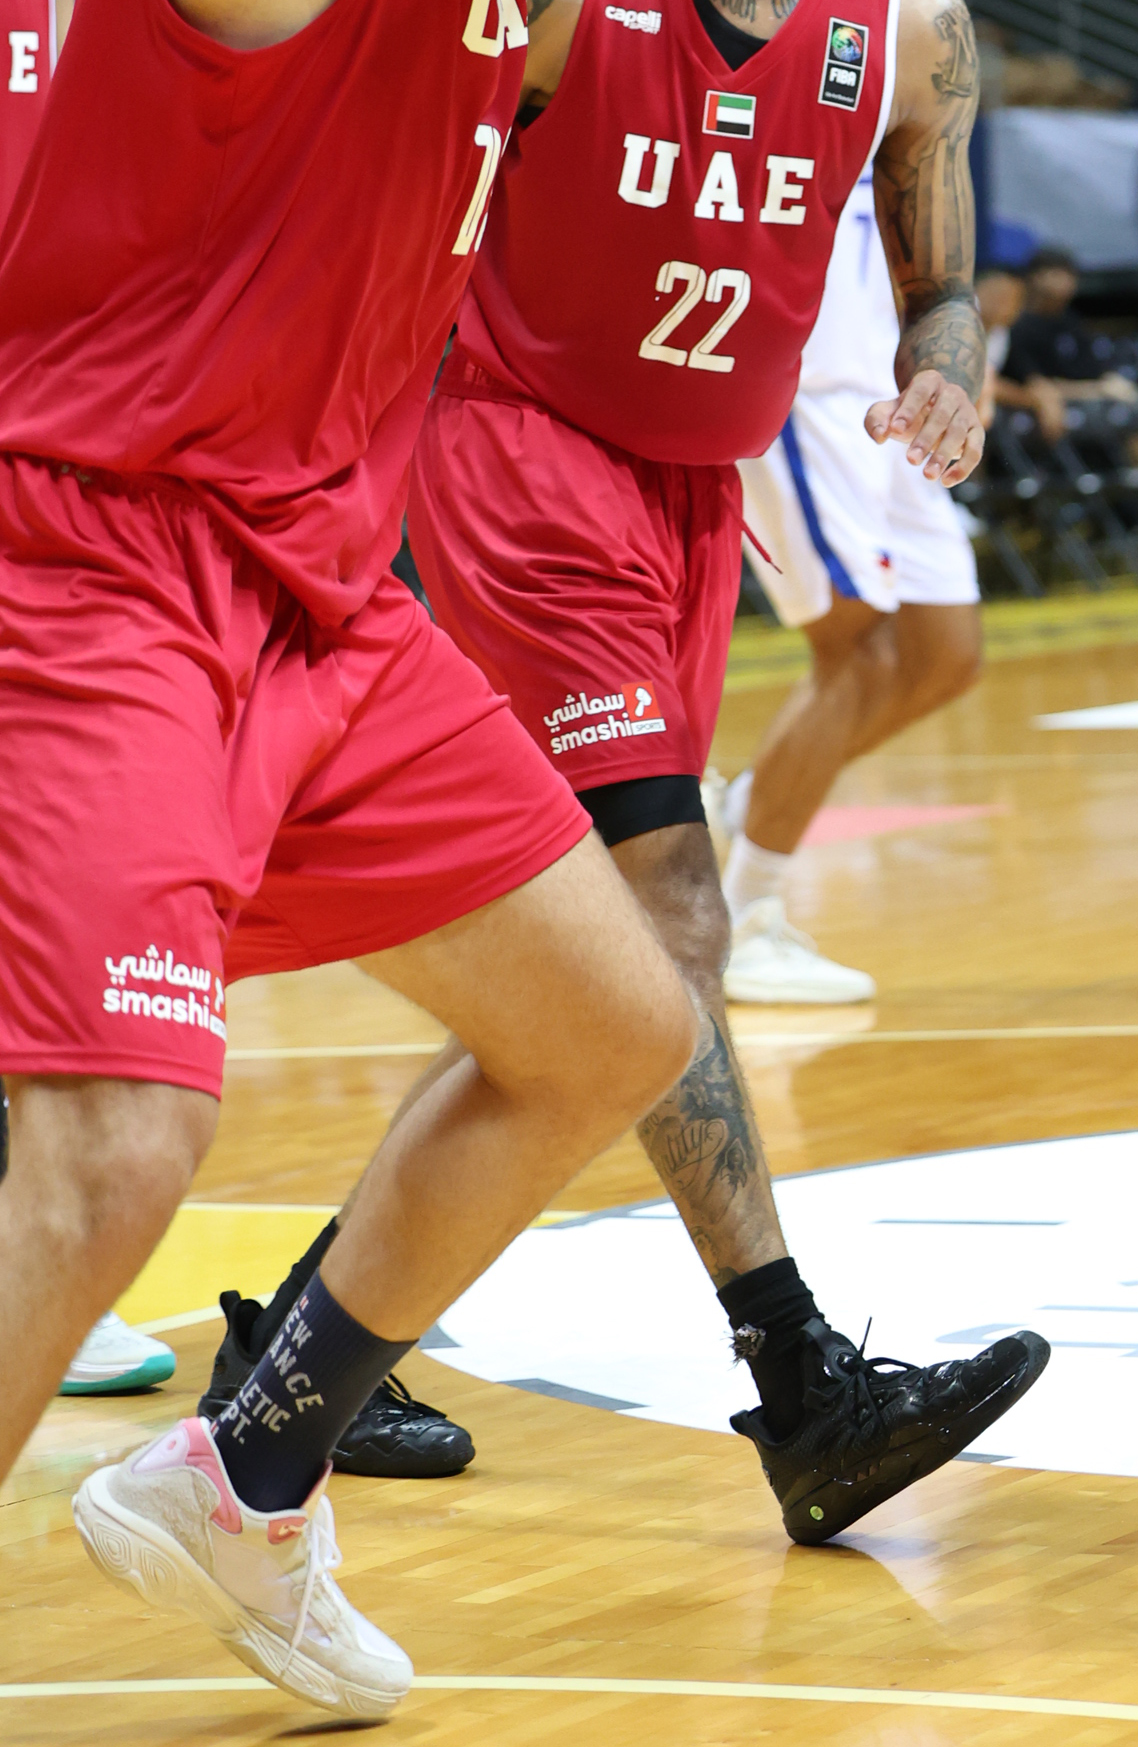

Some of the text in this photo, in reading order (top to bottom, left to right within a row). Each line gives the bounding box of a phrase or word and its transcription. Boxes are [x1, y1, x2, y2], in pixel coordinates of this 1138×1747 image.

[604, 4, 662, 30] capelli
[829, 67, 857, 87] FIBA
[617, 133, 815, 226] UAE
[638, 260, 751, 373] 22
[543, 692, 625, 733] سماشي
[550, 712, 632, 754] smashi
[634, 721, 662, 732] SPORTS
[104, 943, 211, 991] سماشي
[102, 987, 210, 1029] smashi
